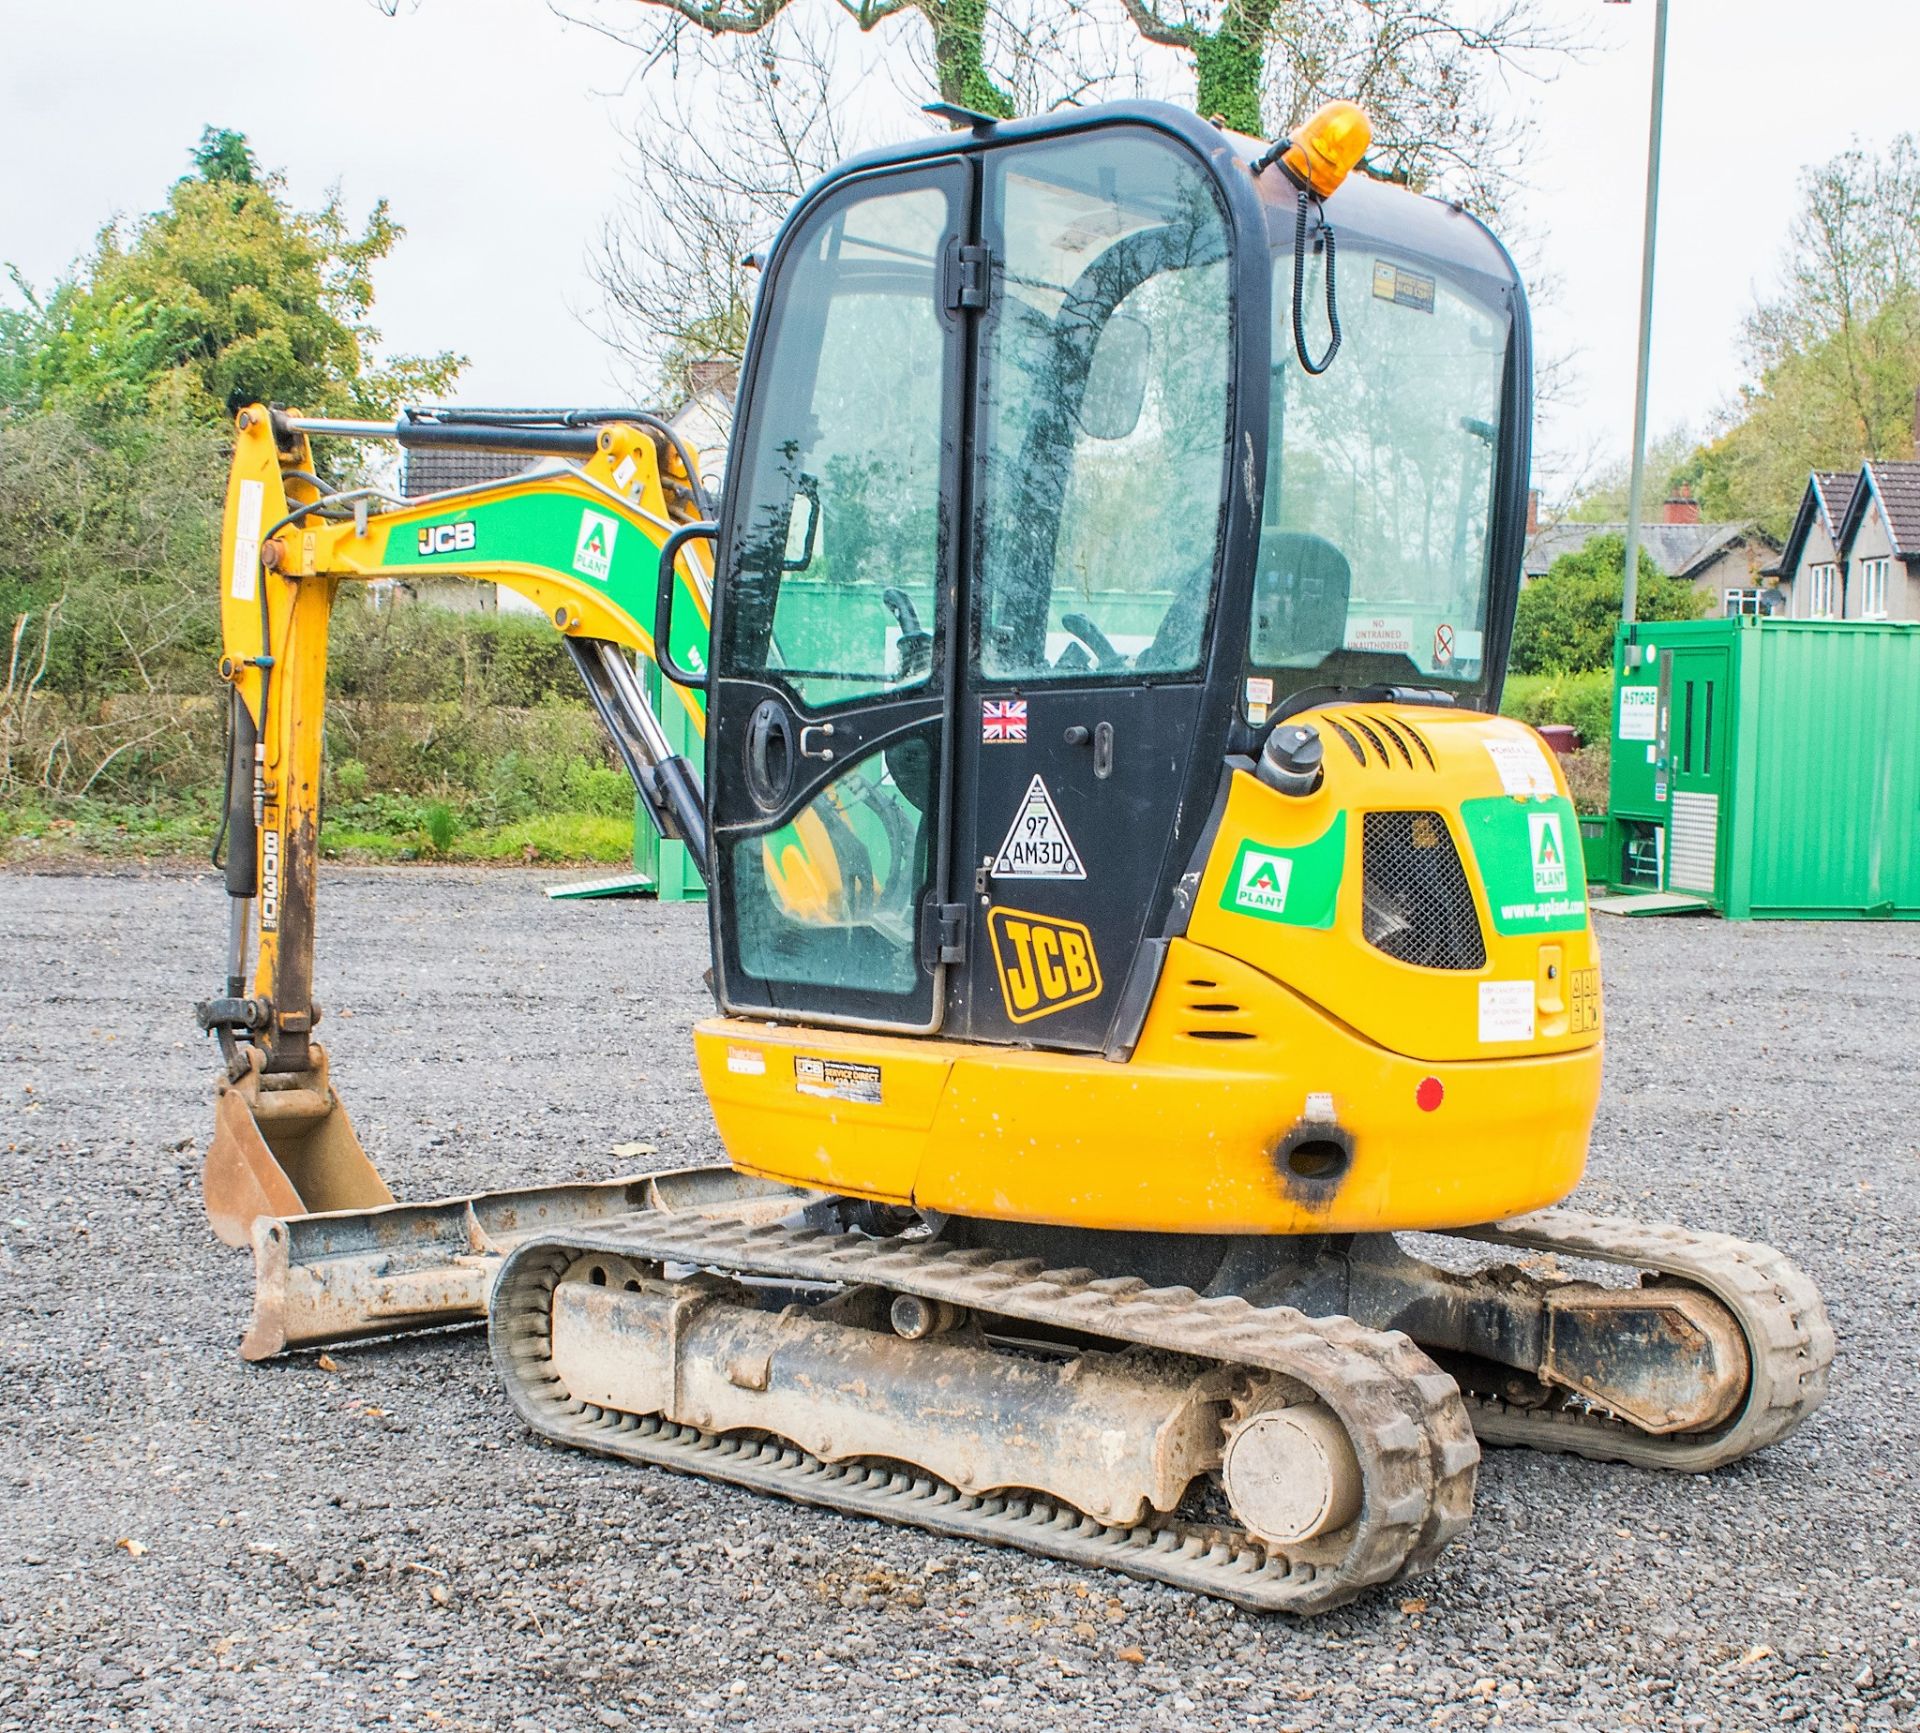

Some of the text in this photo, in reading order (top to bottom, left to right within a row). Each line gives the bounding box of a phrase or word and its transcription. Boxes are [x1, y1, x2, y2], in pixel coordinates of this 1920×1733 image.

[418, 522, 476, 555] JCB
[583, 521, 608, 558] A
[576, 553, 608, 576] PLANT
[1355, 630, 1402, 639] UNTRAINED
[1372, 619, 1385, 628] NO
[1347, 641, 1409, 650] UNAUTHORISED
[1026, 816, 1049, 839] 97
[1013, 841, 1063, 864] AM3D
[1537, 822, 1561, 865] A
[263, 831, 279, 920] 8030
[1246, 861, 1281, 893] A
[1535, 871, 1564, 886] PLANT
[1239, 890, 1283, 908] PLANT
[1005, 920, 1092, 1010] JCB
[853, 1070, 879, 1081] DIRECT
